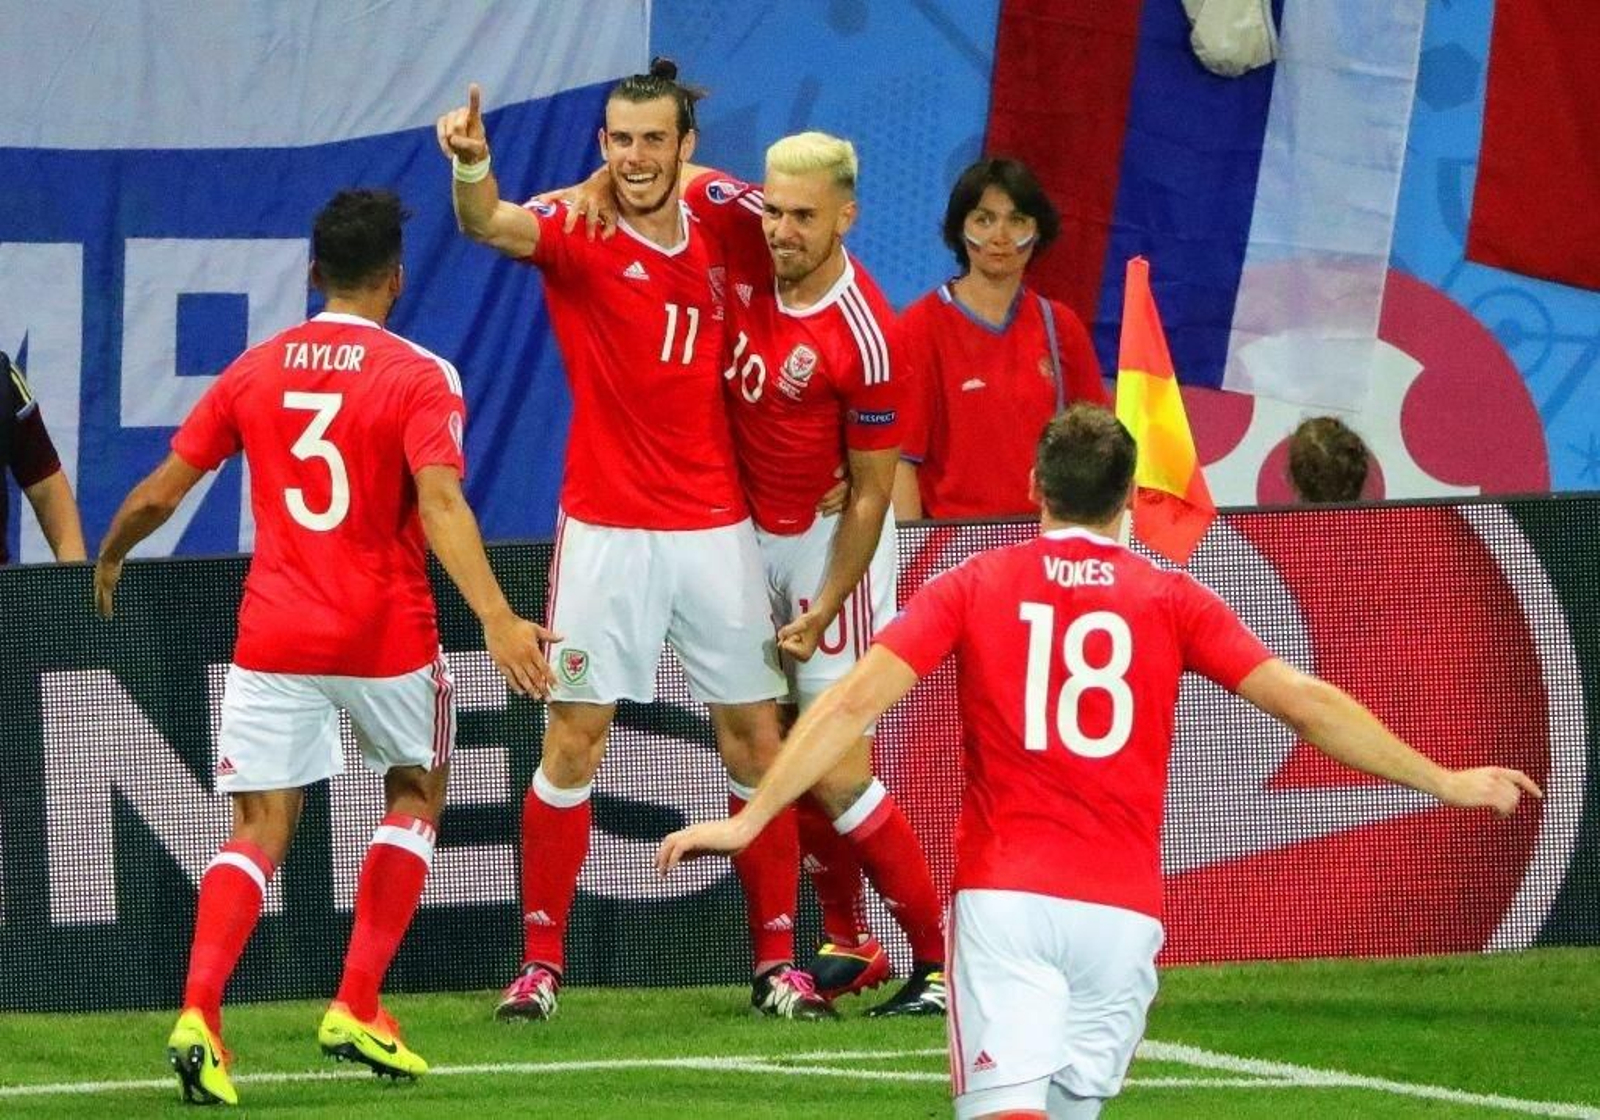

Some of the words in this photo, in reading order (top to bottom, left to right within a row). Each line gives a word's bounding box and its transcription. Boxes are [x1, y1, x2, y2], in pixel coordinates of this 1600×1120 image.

[283, 342, 365, 372] TAYLOR
[660, 303, 699, 364] 11
[724, 331, 766, 403] 10
[860, 411, 896, 423] RESPECT
[283, 391, 350, 532] 3
[1043, 555, 1115, 587] VOKES
[799, 598, 847, 655] 0
[1019, 601, 1134, 758] 18
